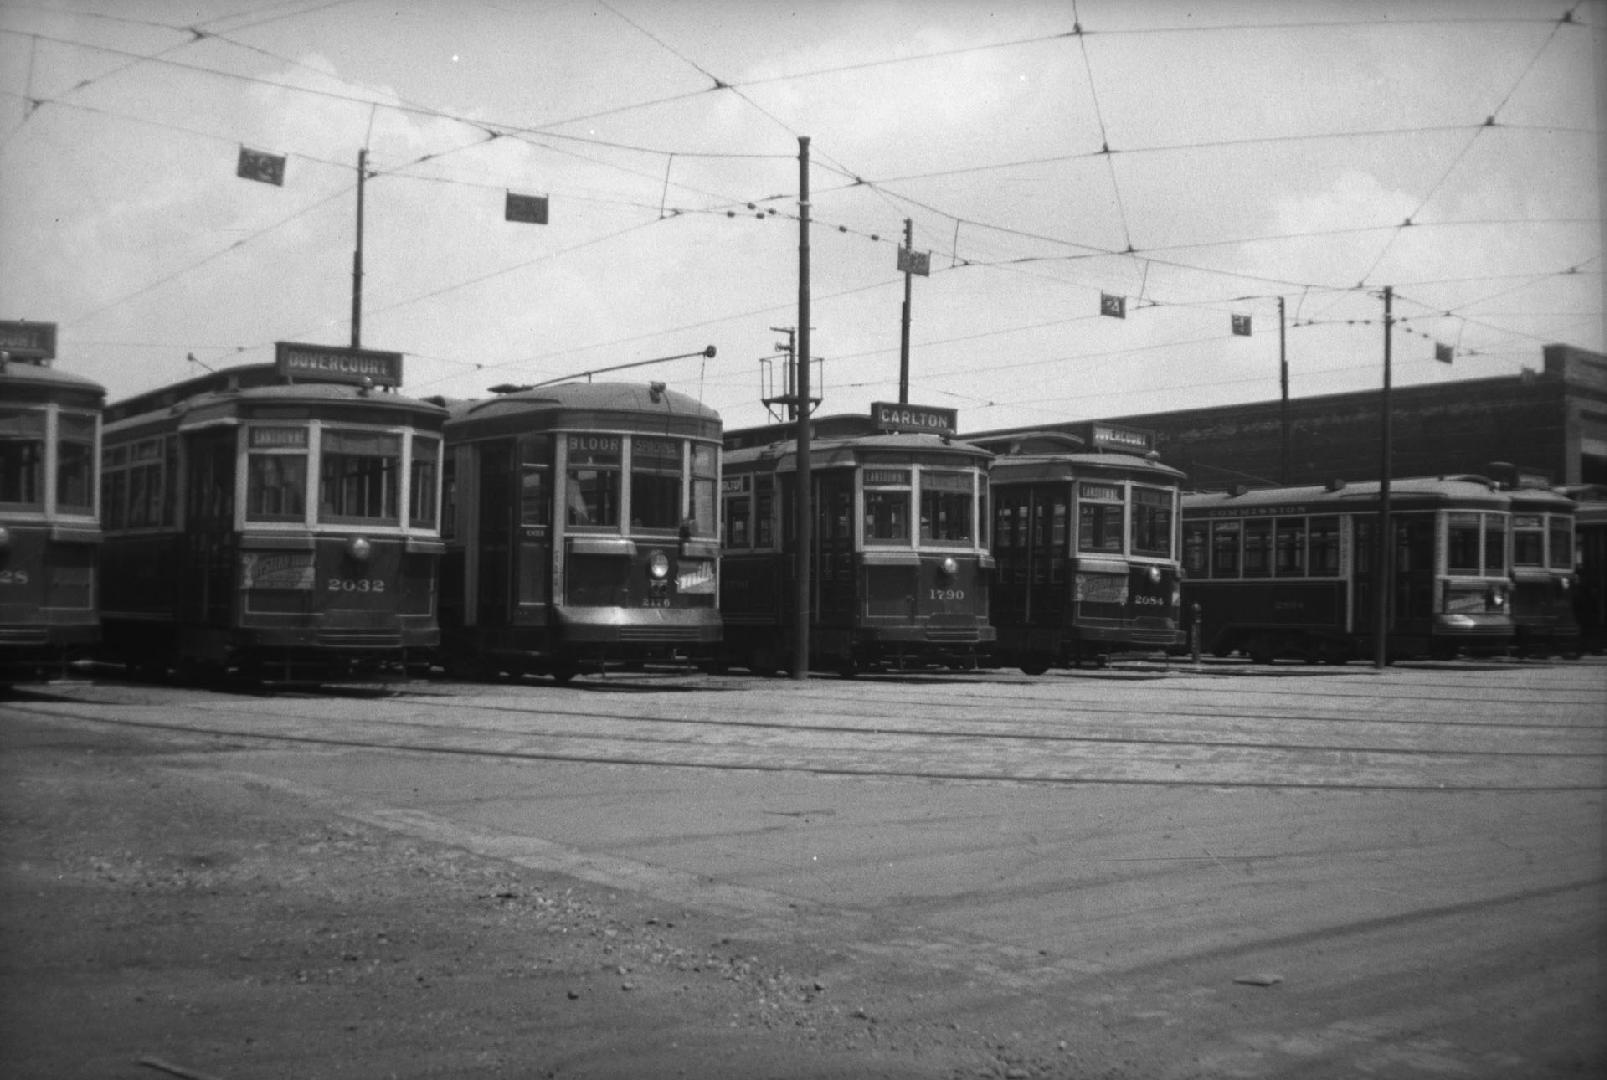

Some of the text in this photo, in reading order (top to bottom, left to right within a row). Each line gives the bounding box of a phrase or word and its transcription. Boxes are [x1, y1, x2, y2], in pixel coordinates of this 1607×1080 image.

[289, 351, 387, 374] DOVERCOURT
[881, 408, 948, 428] CARLTON
[569, 437, 619, 451] BLOOR
[328, 578, 385, 592] 2032
[929, 588, 965, 600] 1790
